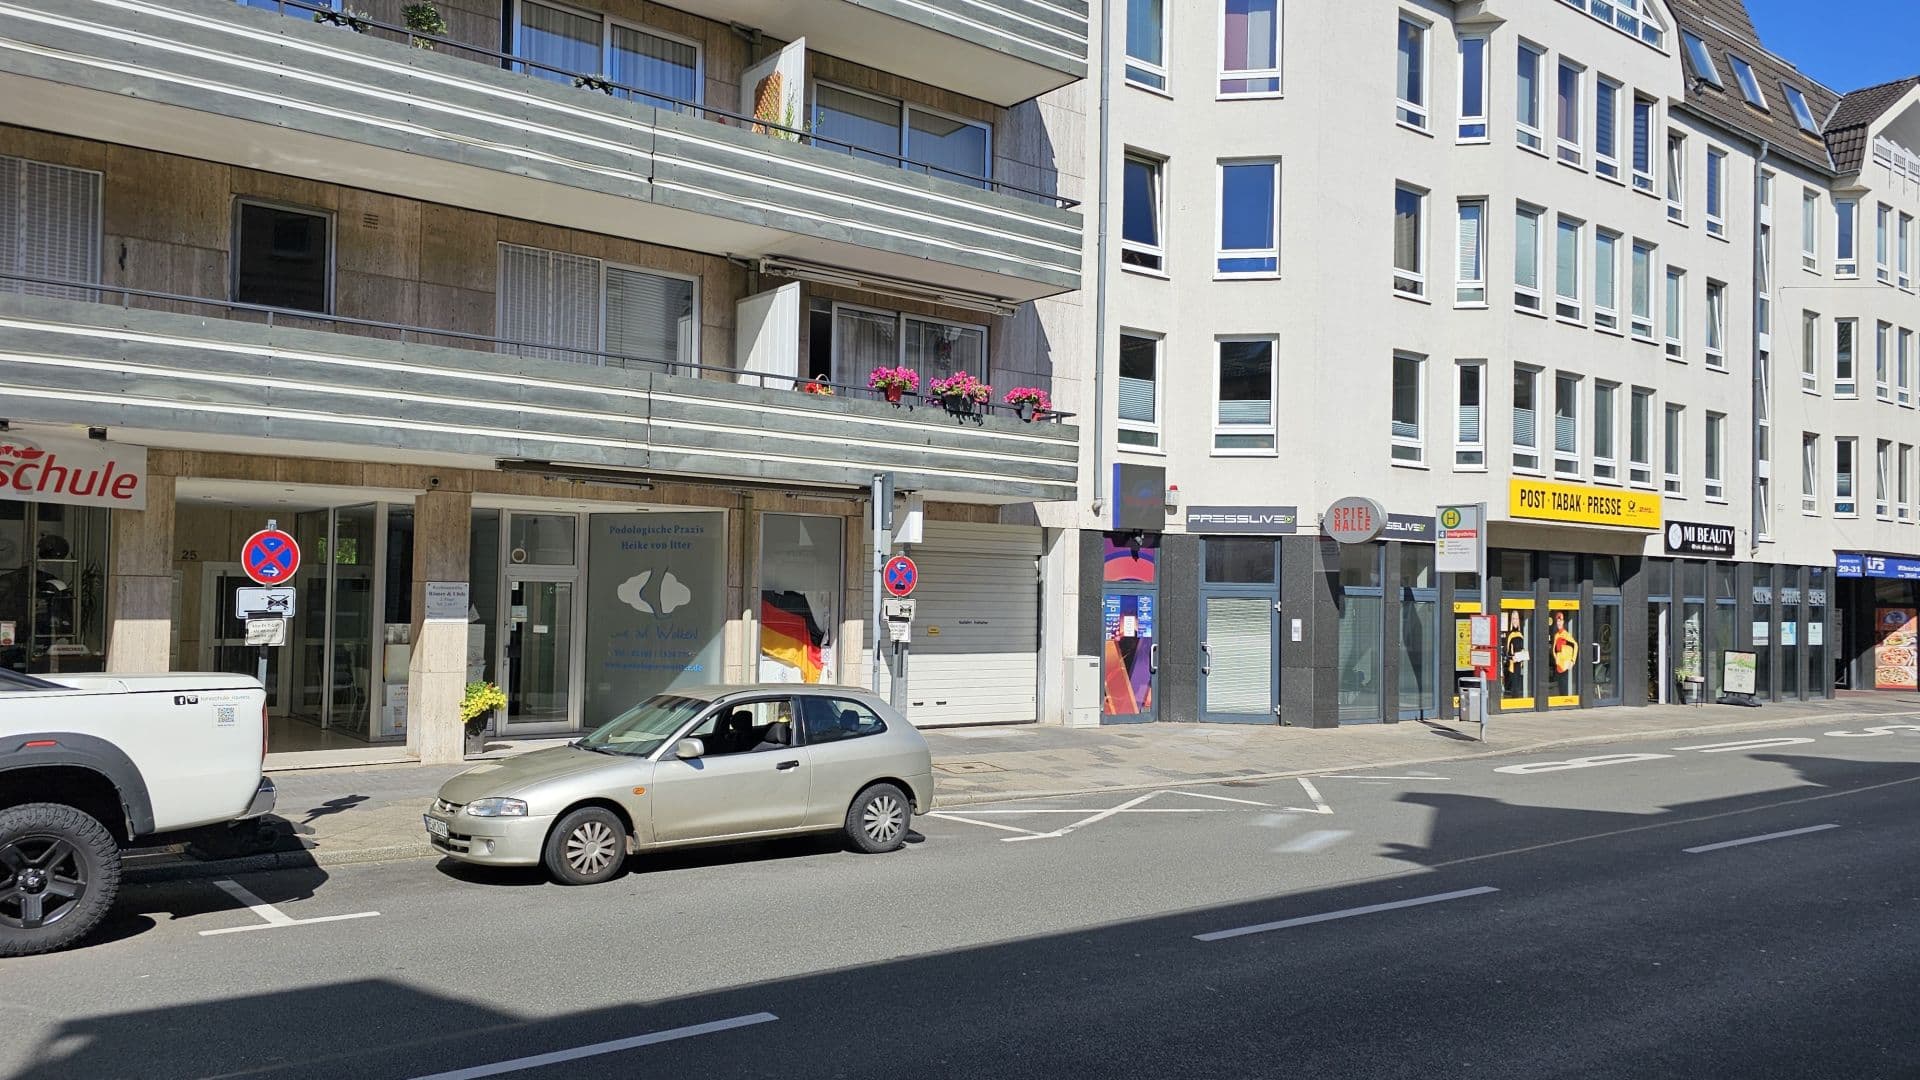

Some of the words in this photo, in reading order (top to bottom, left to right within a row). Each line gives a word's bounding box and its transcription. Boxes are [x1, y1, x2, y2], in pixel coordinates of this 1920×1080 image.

[1520, 489, 1546, 508] POST
[1552, 492, 1581, 512] TABAK
[1587, 496, 1621, 515] PRESSE
[1188, 514, 1286, 524] PRESSLIVE
[1334, 507, 1371, 520] SPIEL
[1447, 511, 1456, 524] H
[609, 525, 672, 536] Podologische
[674, 525, 705, 534] Praxis
[1334, 518, 1371, 532] HALLE
[1684, 526, 1695, 541] MI
[1698, 527, 1734, 544] BEAUTY
[621, 540, 648, 550] Heike
[182, 550, 199, 560] 25
[1838, 565, 1860, 573] 29-31
